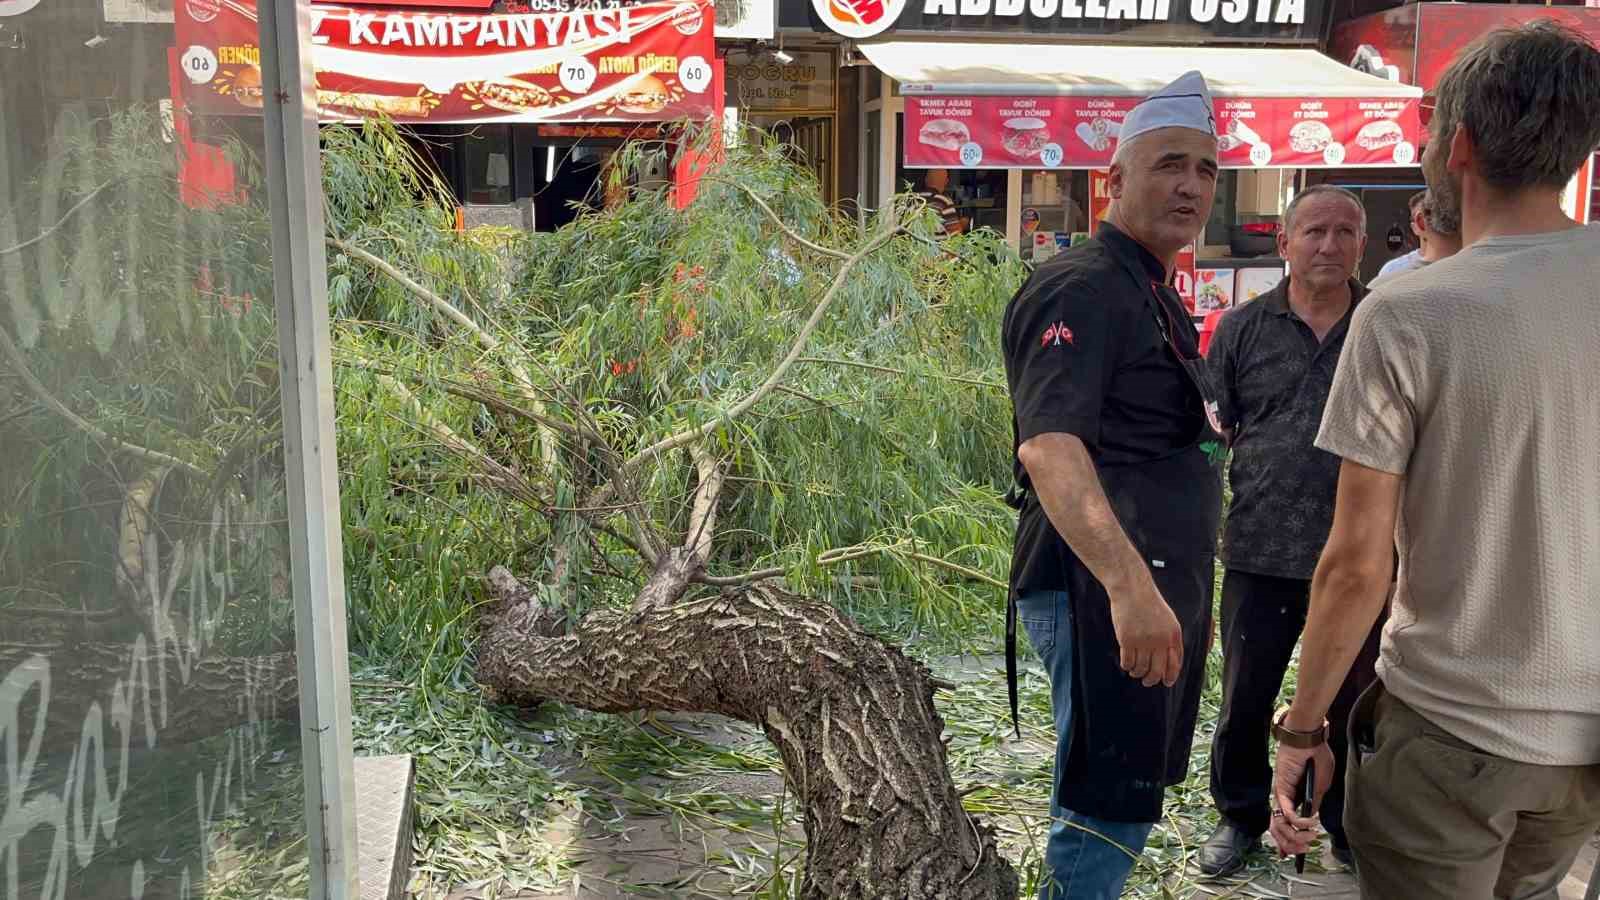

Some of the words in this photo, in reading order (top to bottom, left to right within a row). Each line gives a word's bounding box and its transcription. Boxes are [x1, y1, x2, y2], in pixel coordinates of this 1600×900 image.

[350, 8, 631, 47] KAMPANYASI
[599, 56, 635, 74] ATOM
[638, 52, 678, 74] DÖNER
[567, 68, 586, 81] 70
[686, 68, 702, 80] 60
[920, 108, 944, 116] TAVUK
[947, 107, 973, 116] DÖNER
